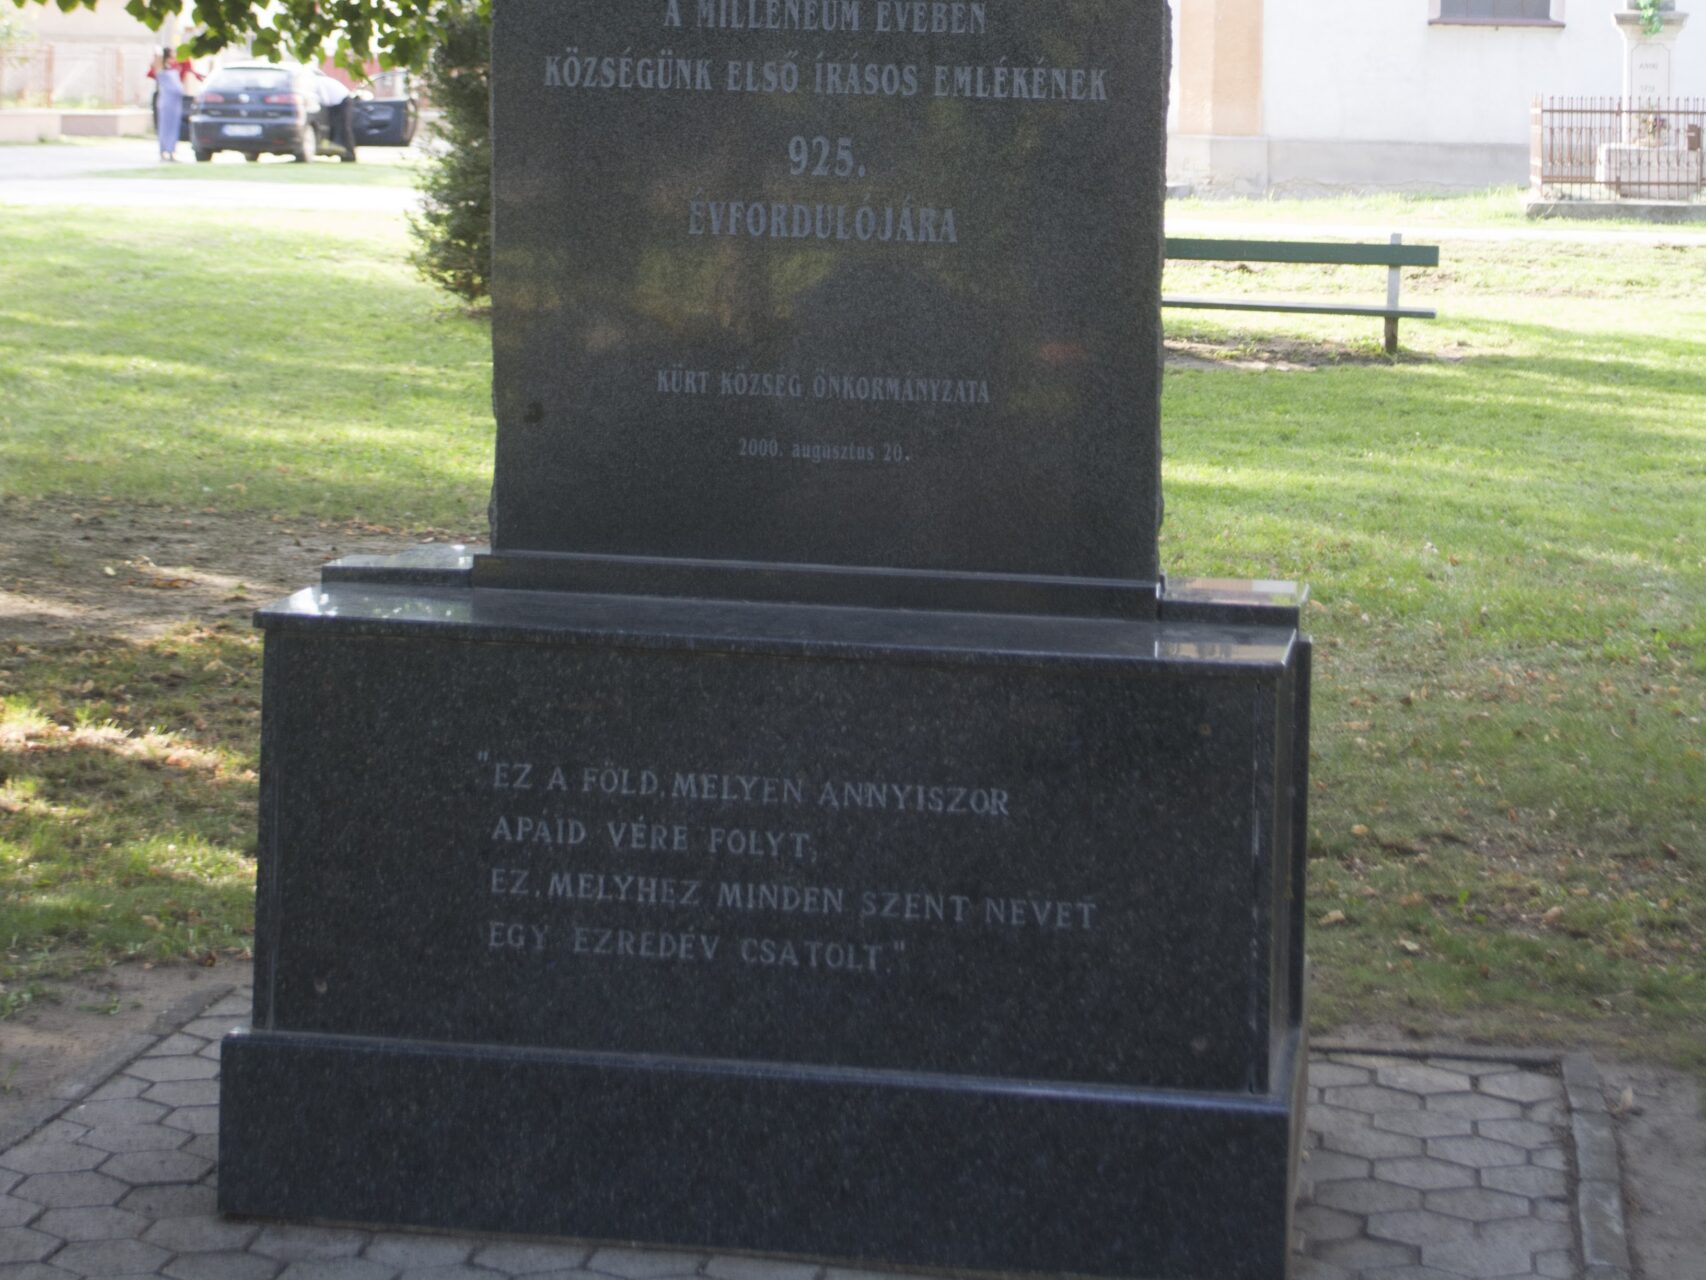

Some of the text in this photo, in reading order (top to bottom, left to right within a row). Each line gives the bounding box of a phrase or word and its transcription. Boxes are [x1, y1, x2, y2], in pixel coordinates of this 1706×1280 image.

[544, 46, 1107, 100] KÖZSÉGÜNK ELSŐ ÍRÁSOS EMLÉKÉNEK
[788, 135, 866, 177] 925.
[688, 190, 958, 242] ÉVFORDULÓJÁRA
[657, 363, 990, 403] KÜRT KÖZSÉG ÖNKORMÁNYZATA
[739, 438, 910, 463] 2000. augusztus 20.
[547, 767, 568, 791] A
[671, 772, 803, 803] MELYEN
[819, 781, 1009, 817] ANNYISZOR
[608, 815, 687, 850] VÉRE
[548, 872, 701, 906] MELYHEZ
[717, 882, 843, 914] MINDEN
[861, 892, 970, 923] SZENT
[985, 898, 1097, 930] NEVET
[489, 921, 549, 951] EGY
[572, 924, 719, 960] EZREDÉV
